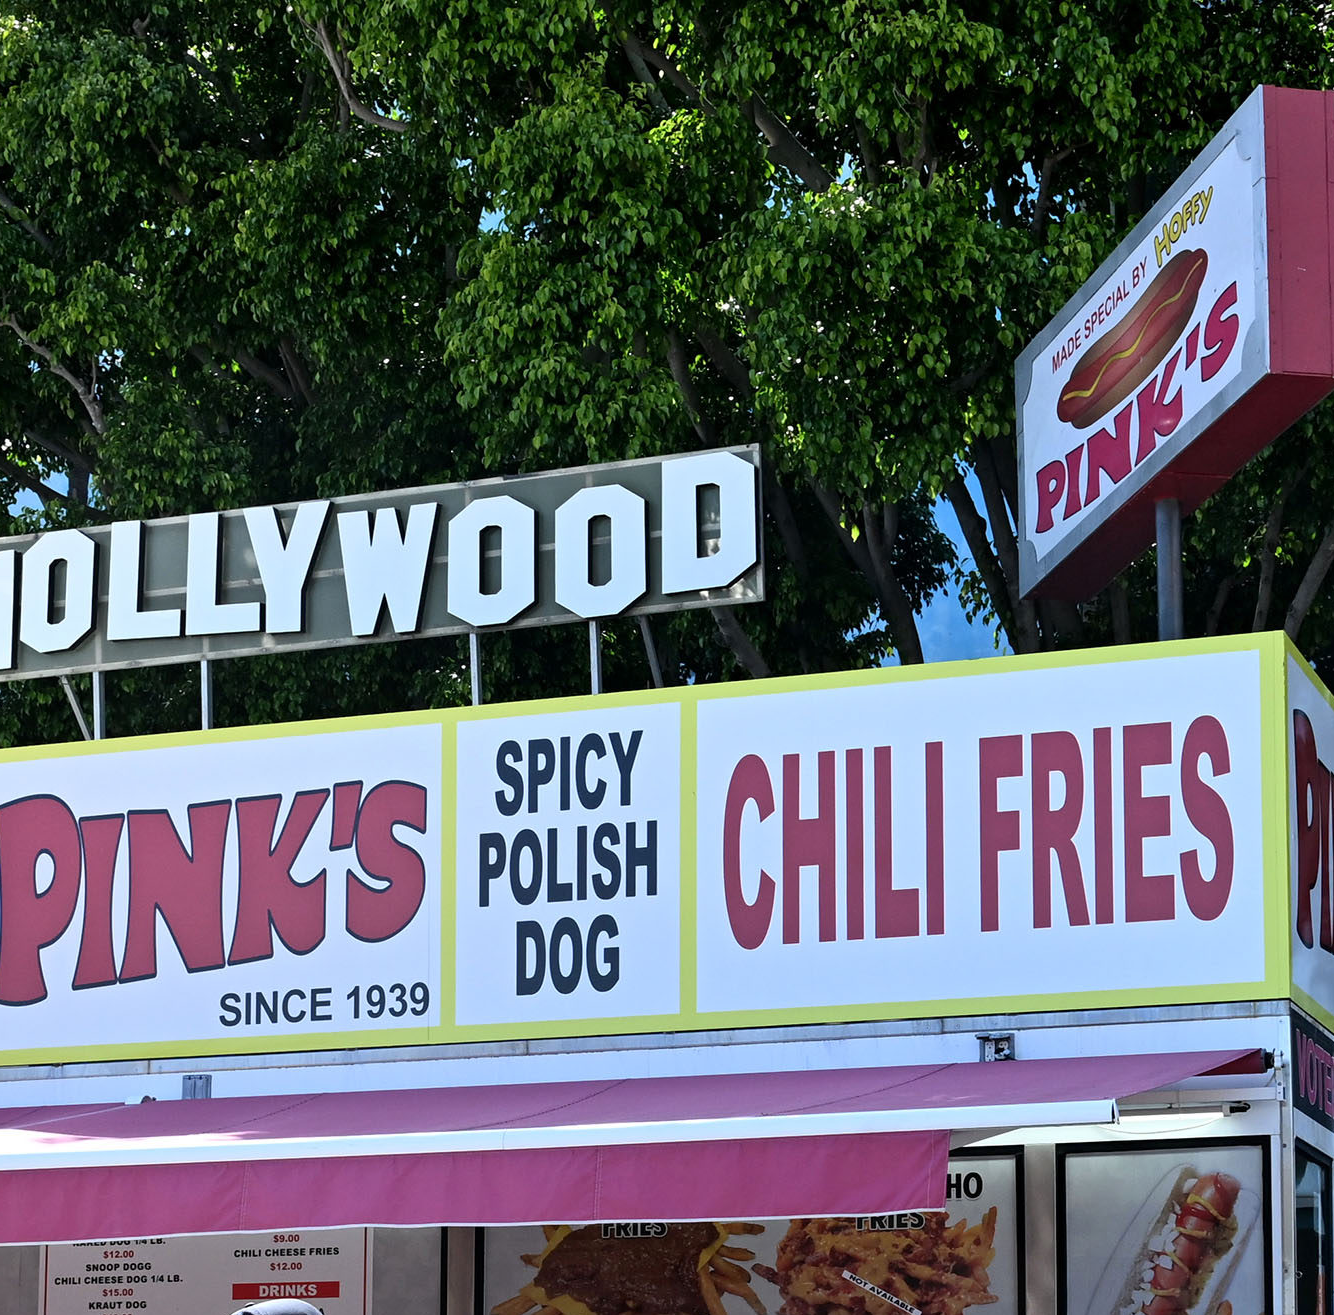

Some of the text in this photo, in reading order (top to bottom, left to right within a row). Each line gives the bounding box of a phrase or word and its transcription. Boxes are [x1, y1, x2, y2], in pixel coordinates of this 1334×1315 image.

[1051, 186, 1213, 374] MADE SPECIAL BY HOFFY
[1035, 281, 1239, 534] PINK'S
[495, 729, 643, 817] SPICY
[723, 714, 1235, 950] CHILI FRIES
[478, 820, 658, 908] POLISH
[515, 913, 620, 997] DOG
[219, 981, 430, 1027] SINCE 1939
[273, 1234, 300, 1243] $9.00
[103, 1251, 134, 1259] $12.00
[234, 1247, 340, 1258] CHILI CHEESE FRIES
[86, 1262, 152, 1272] SNOOP DOGG
[270, 1262, 303, 1271] $12.00
[54, 1274, 184, 1286] CHILI CHEESE DOG 1/4 LB.
[102, 1289, 134, 1297] $15.00
[259, 1284, 317, 1297] DRINKS
[848, 1274, 915, 1314] NOT AVAILABLE
[88, 1301, 147, 1310] KRAUT DOG
